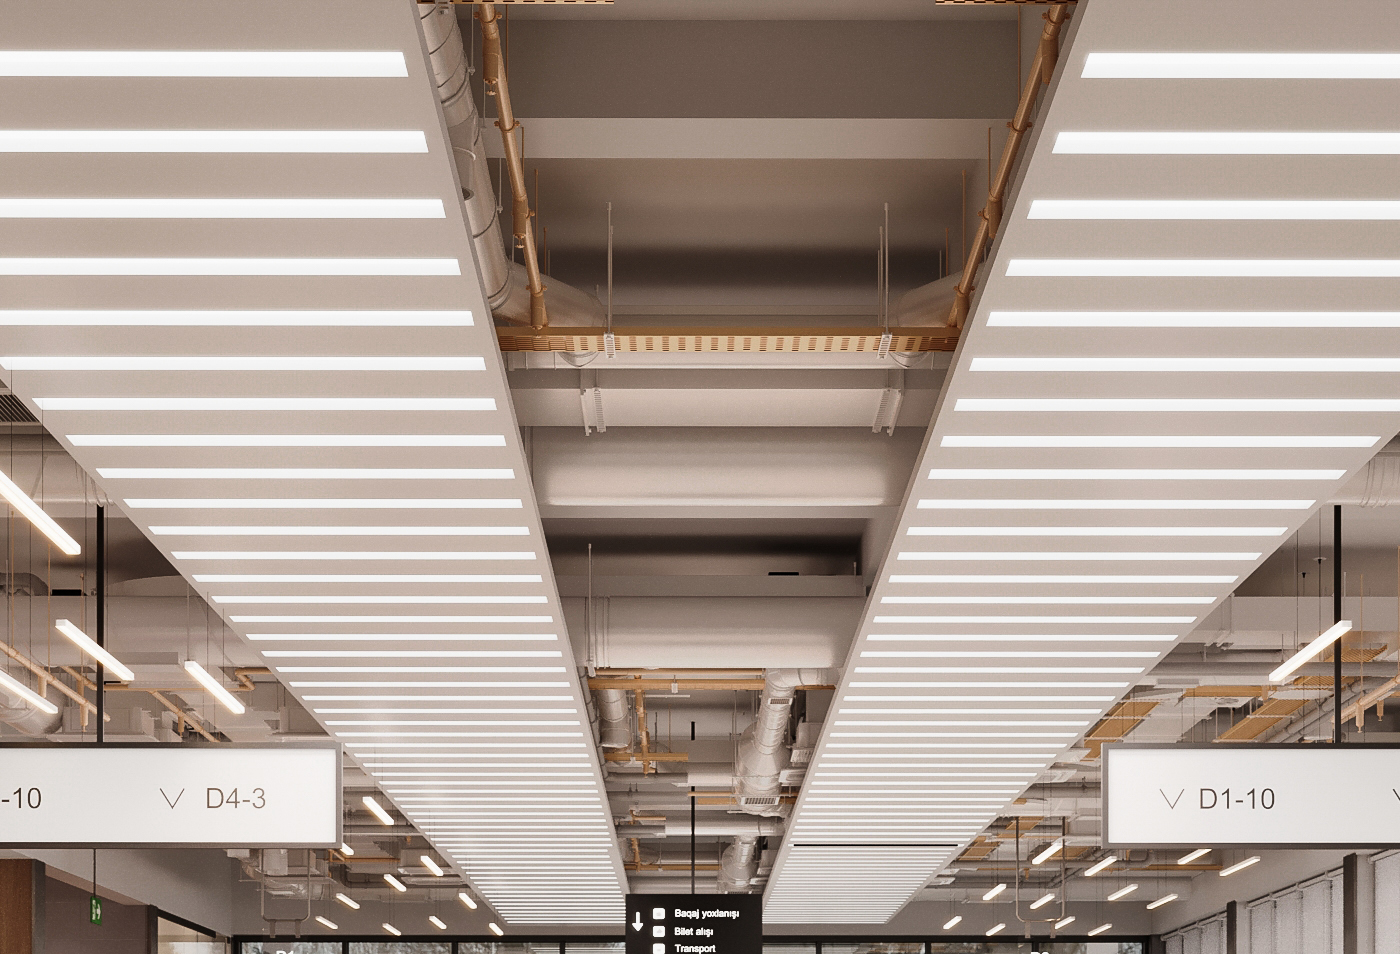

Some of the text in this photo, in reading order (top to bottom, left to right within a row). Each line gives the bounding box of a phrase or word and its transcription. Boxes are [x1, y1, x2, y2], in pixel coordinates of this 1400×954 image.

[205, 787, 267, 810] D4-3
[1199, 788, 1276, 810] D1-10
[674, 926, 694, 936] Bilet
[674, 943, 716, 954] Transport
